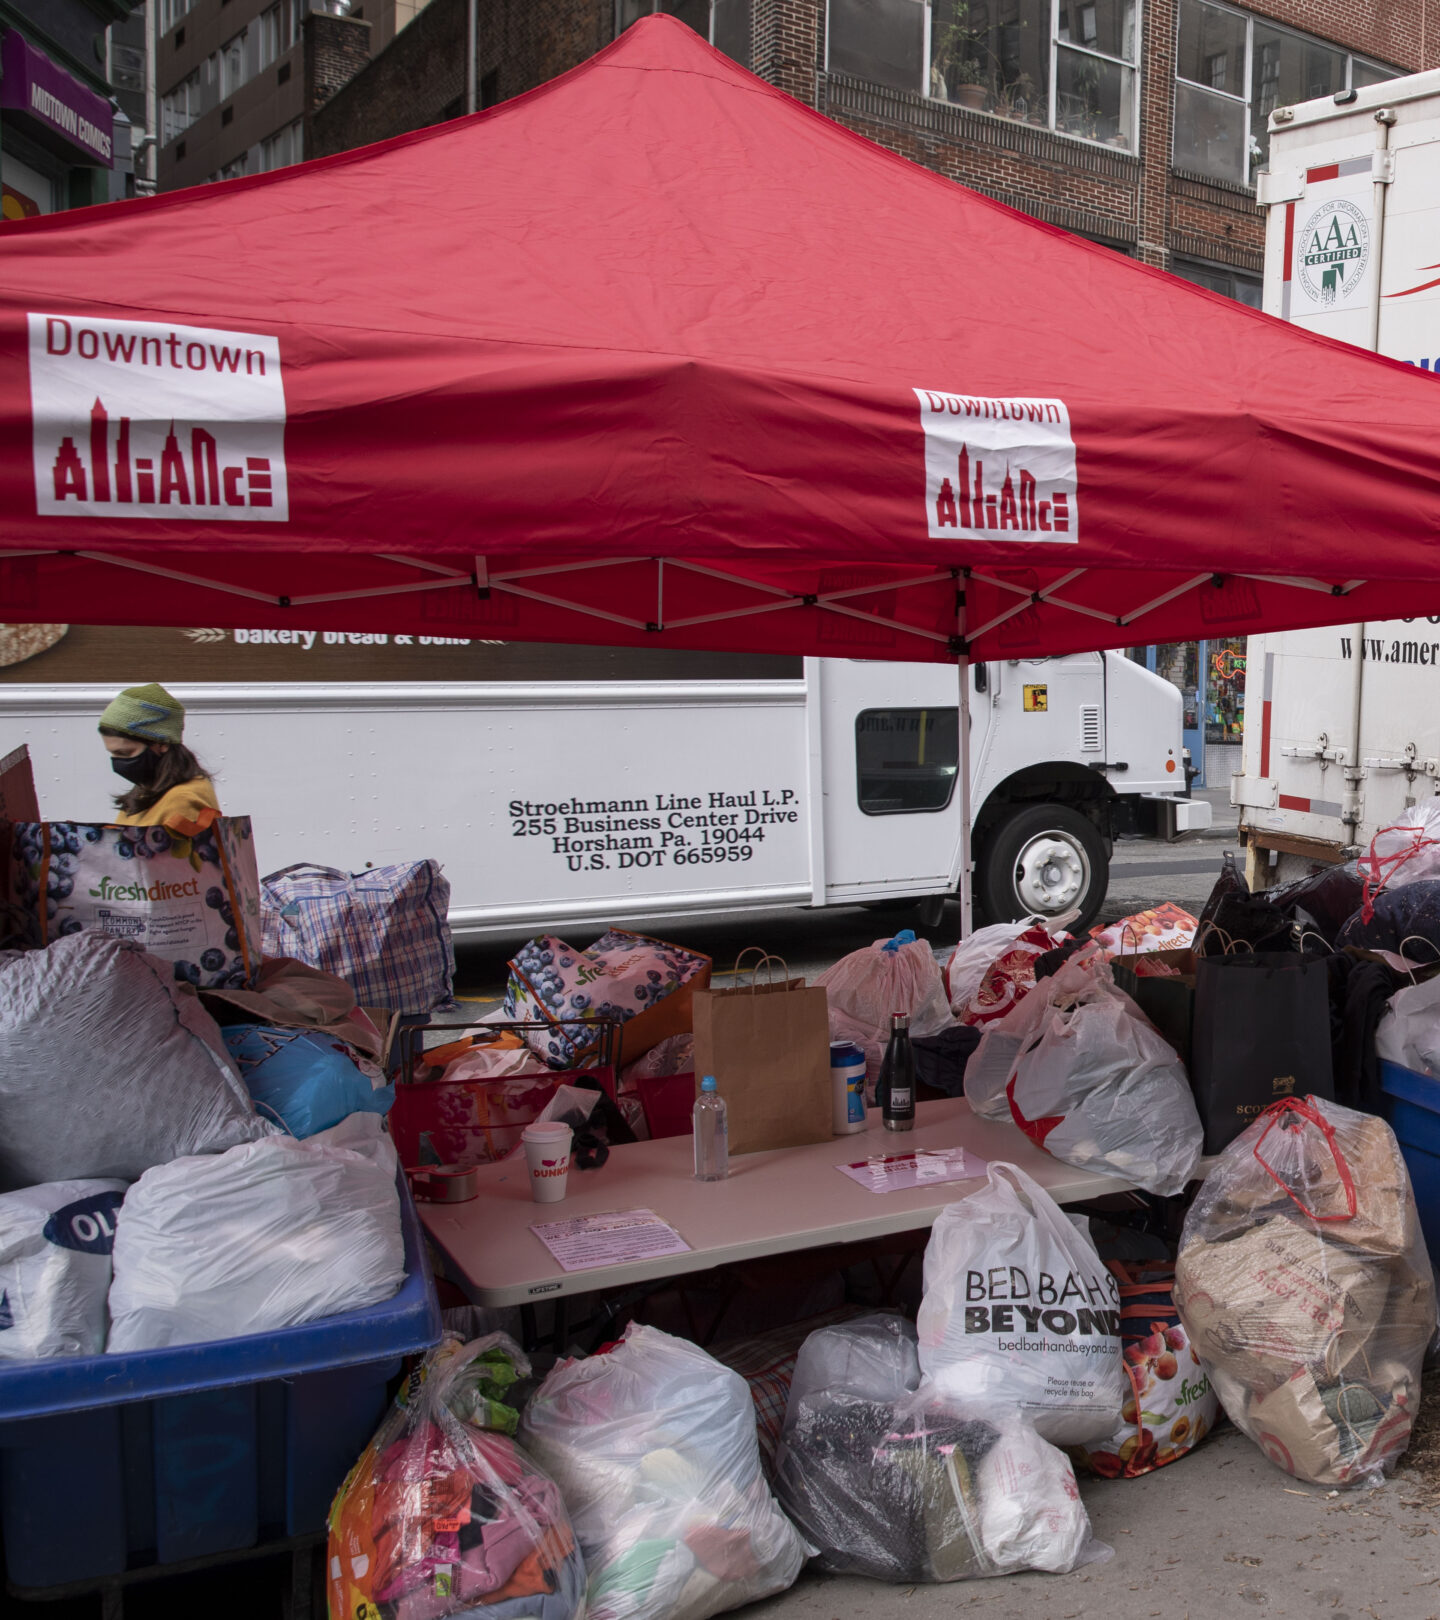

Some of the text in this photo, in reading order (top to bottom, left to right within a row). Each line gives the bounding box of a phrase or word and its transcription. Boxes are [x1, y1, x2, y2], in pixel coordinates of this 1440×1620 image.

[31, 82, 112, 160] MIDTOWN COMICS
[1308, 215, 1359, 254] AAA
[1307, 248, 1359, 265] CERTIFIED
[46, 318, 266, 377] Downtown
[925, 391, 1060, 424] Downtown
[234, 629, 317, 649] bakery
[509, 790, 800, 818] Stroehmann Line Haul L.P.
[512, 808, 799, 836] 255 Business Center Drive
[552, 827, 765, 853] Horsham Pa. 19044
[567, 845, 754, 872] U.S. DOT 665959
[98, 876, 200, 901] freshdirect
[105, 925, 138, 935] PANTRY
[71, 1207, 121, 1242] OL
[1264, 1238, 1283, 1257] BAG
[1283, 1252, 1304, 1271] THIS
[966, 1266, 1031, 1302] BED
[965, 1304, 1122, 1338] BEYOND
[1044, 1388, 1096, 1400] recycle this bag.
[1047, 1376, 1096, 1388] Please reuse or
